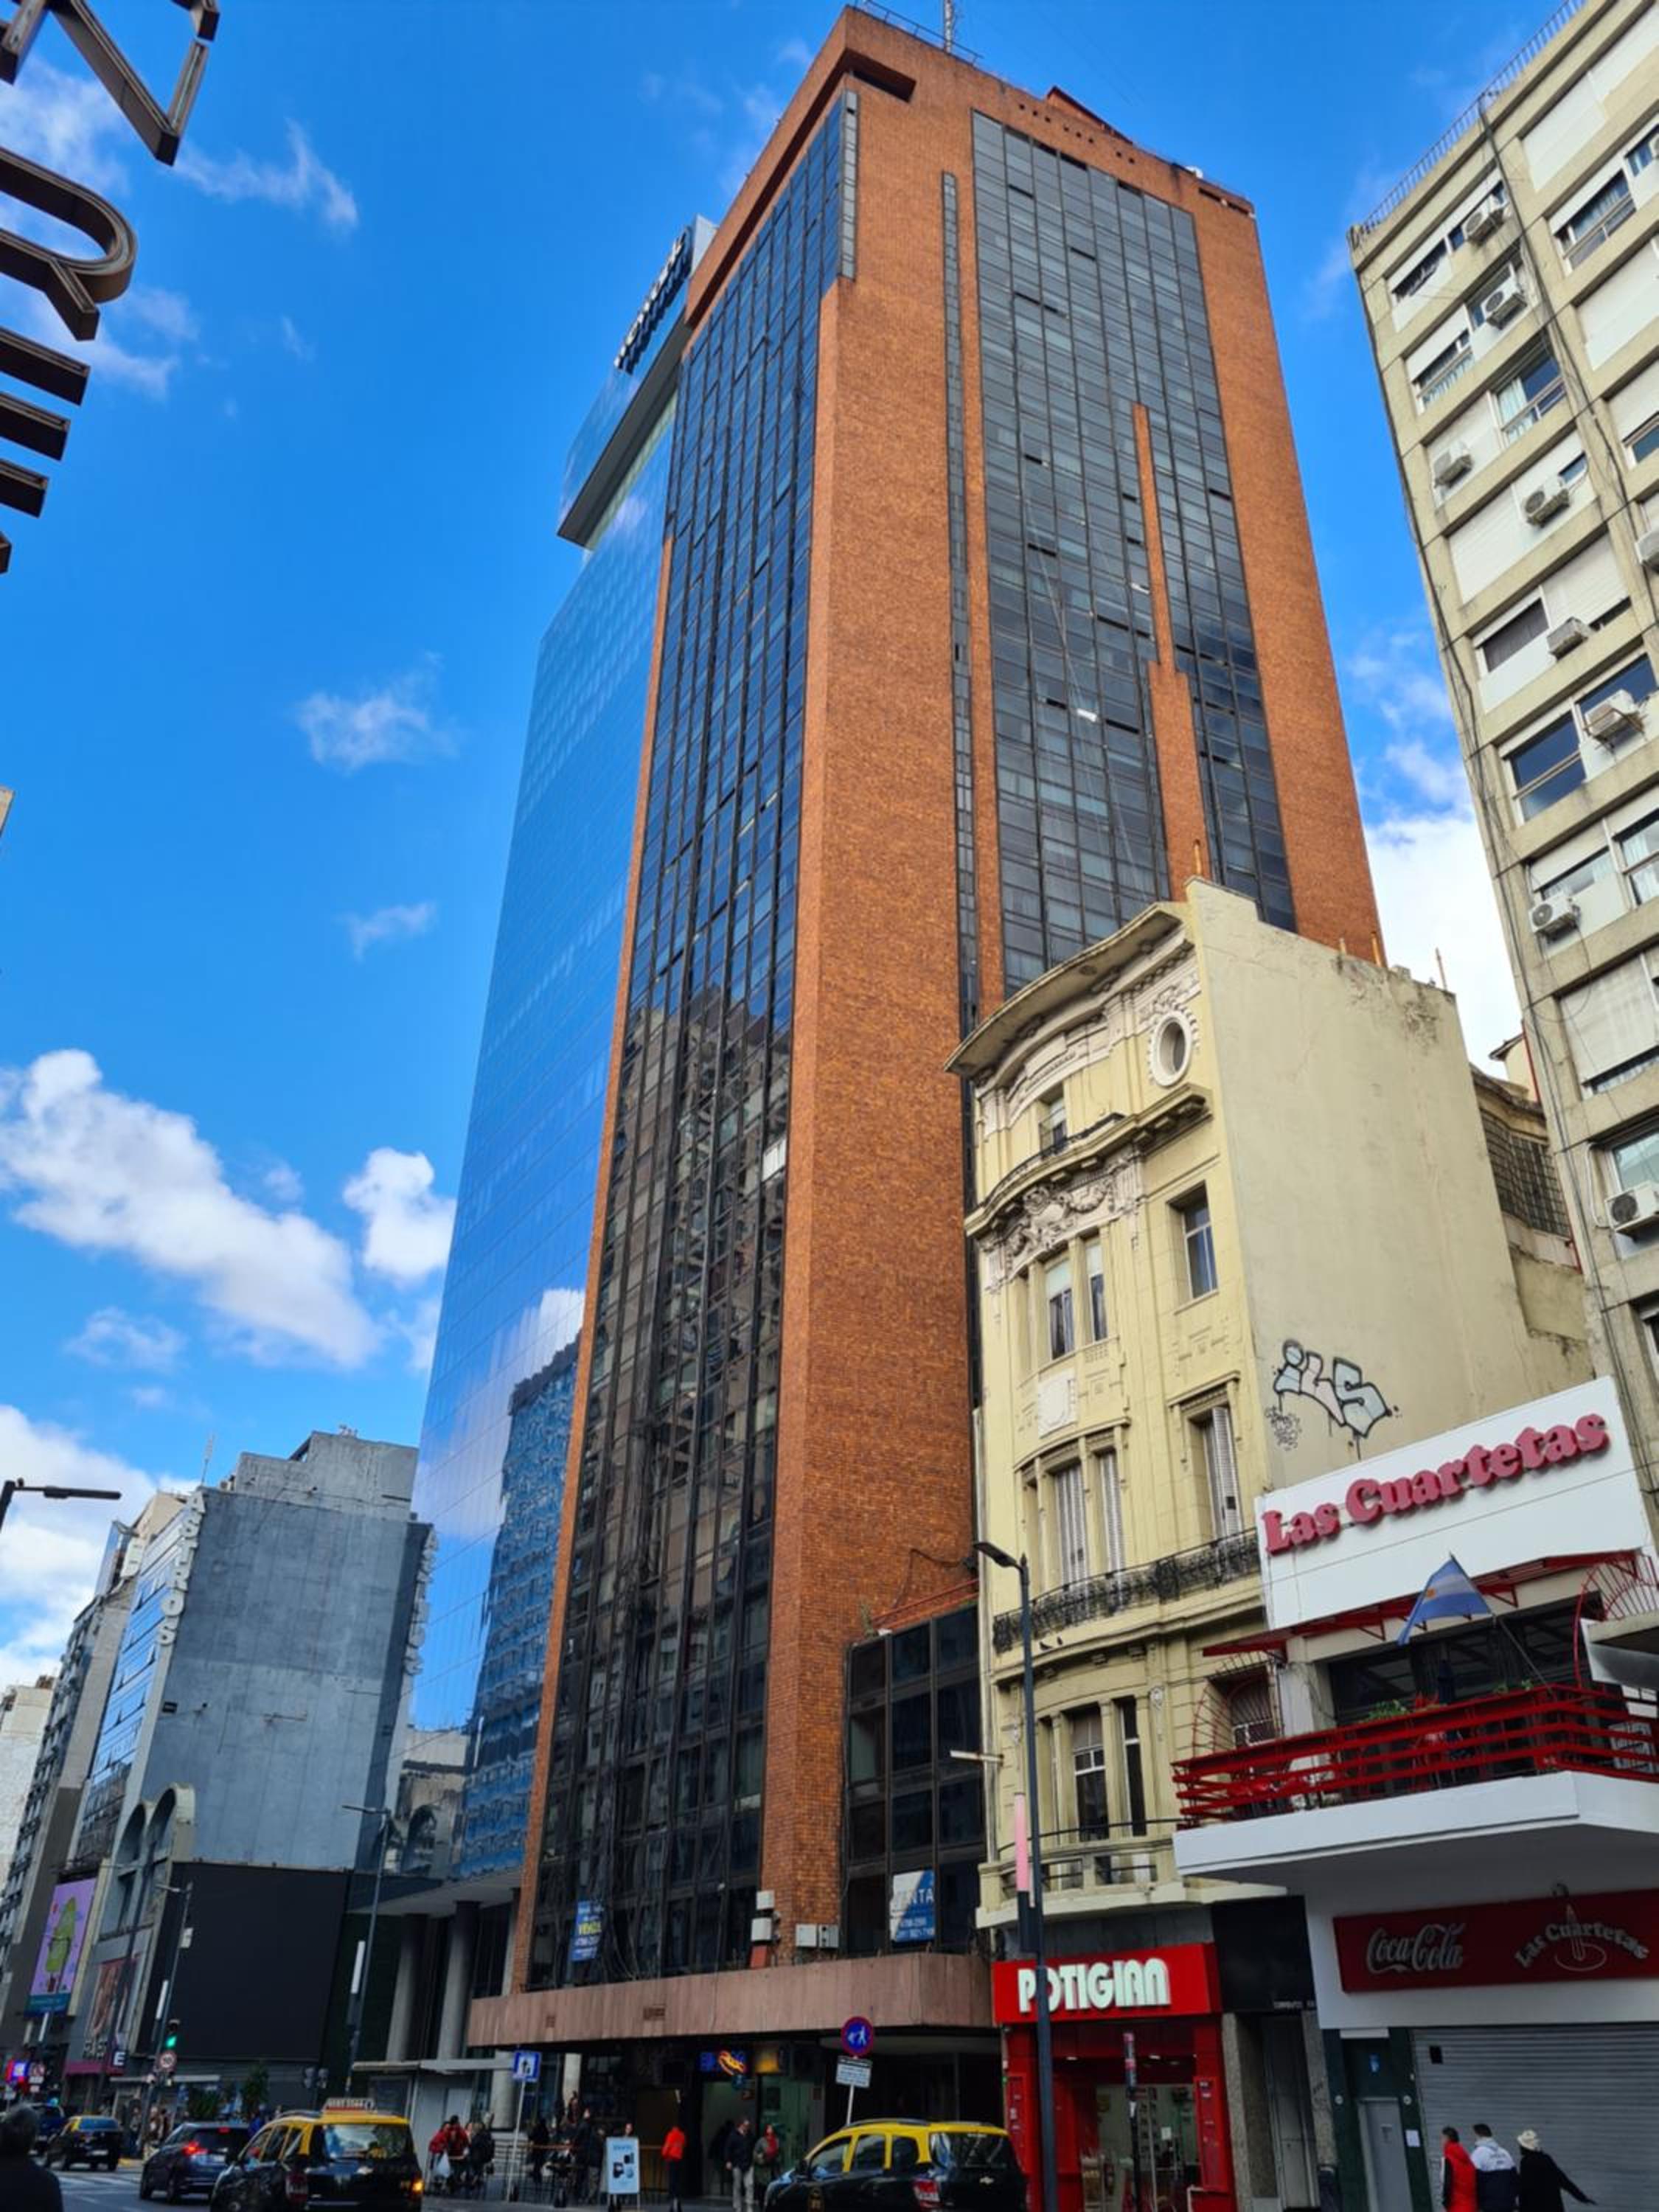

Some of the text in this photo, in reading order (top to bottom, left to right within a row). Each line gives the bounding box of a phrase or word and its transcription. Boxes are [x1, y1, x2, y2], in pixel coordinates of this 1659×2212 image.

[1262, 1503, 1340, 1556] Las
[1346, 1413, 1610, 1523] Cuartetas
[156, 1491, 206, 1646] ASTROS
[1514, 1922, 1651, 1969] Las Cuartetas
